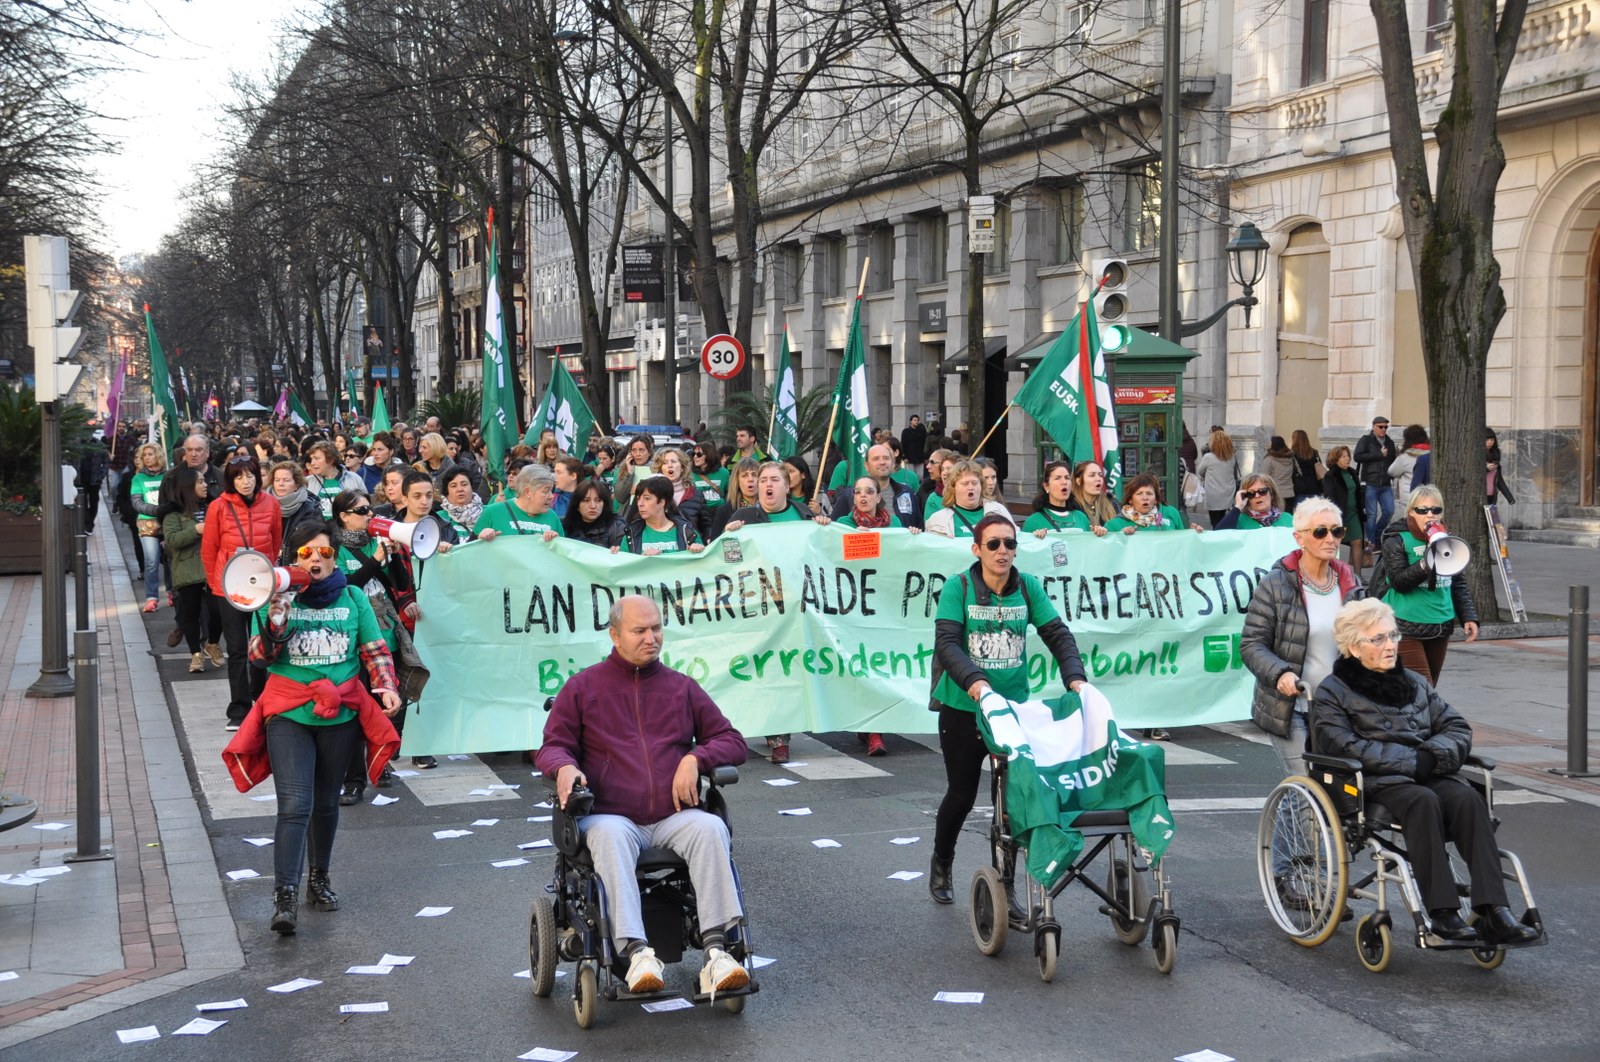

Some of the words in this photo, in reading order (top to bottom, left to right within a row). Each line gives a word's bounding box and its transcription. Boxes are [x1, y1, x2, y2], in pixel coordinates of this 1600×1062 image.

[712, 350, 734, 364] 30
[503, 582, 576, 635] LAN
[591, 566, 785, 632] DNAREN
[800, 564, 878, 617] ALDE
